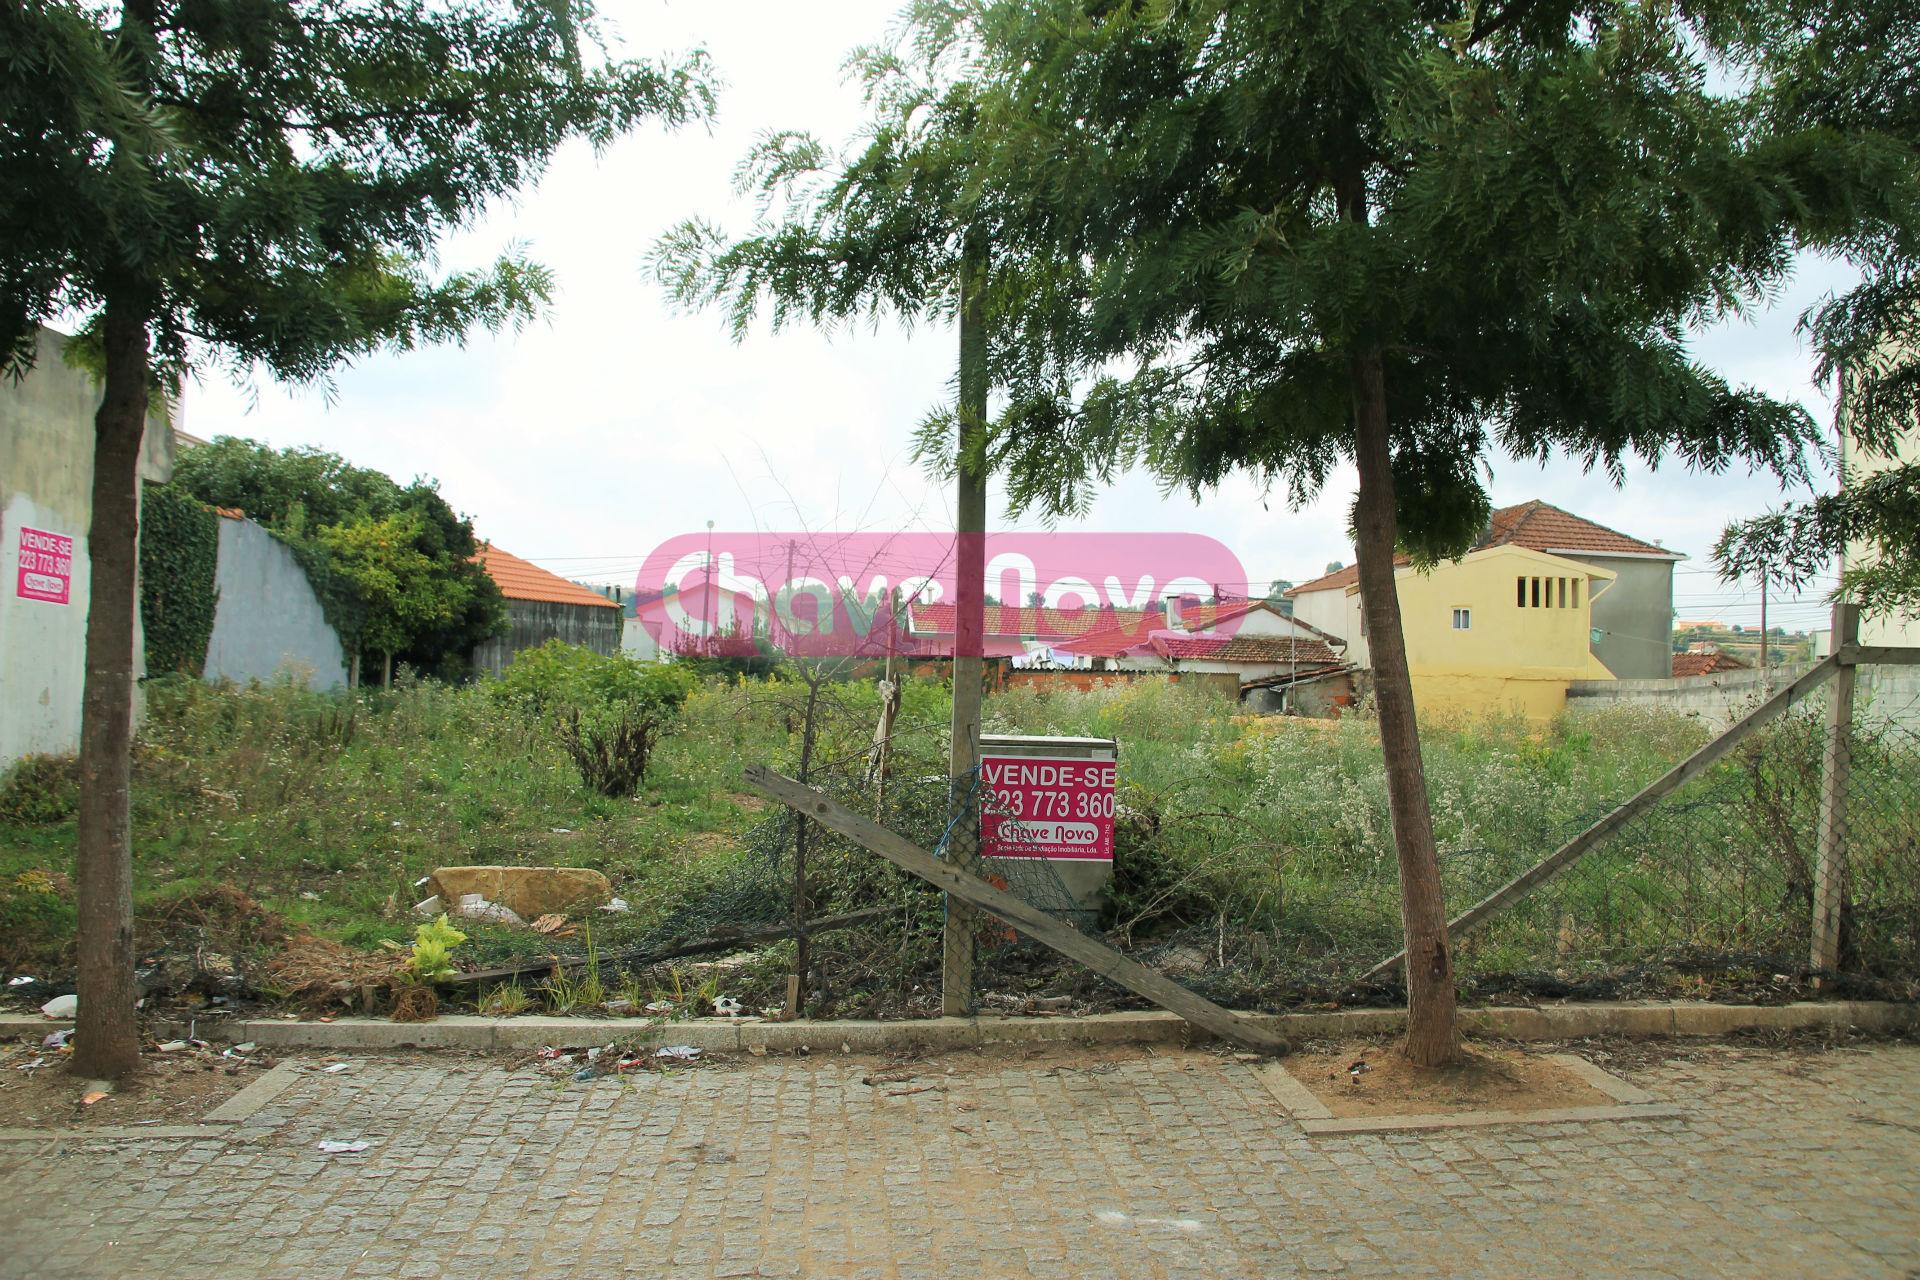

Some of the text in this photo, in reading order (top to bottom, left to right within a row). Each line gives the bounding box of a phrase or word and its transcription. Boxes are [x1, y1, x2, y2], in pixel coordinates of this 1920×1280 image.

[20, 531, 72, 557] VENDE-SE
[20, 550, 37, 570] 223
[38, 554, 54, 574] 773
[985, 764, 1116, 788] VENDE-SE
[984, 790, 1115, 818] 223 773 360
[1002, 824, 1049, 842] Chave
